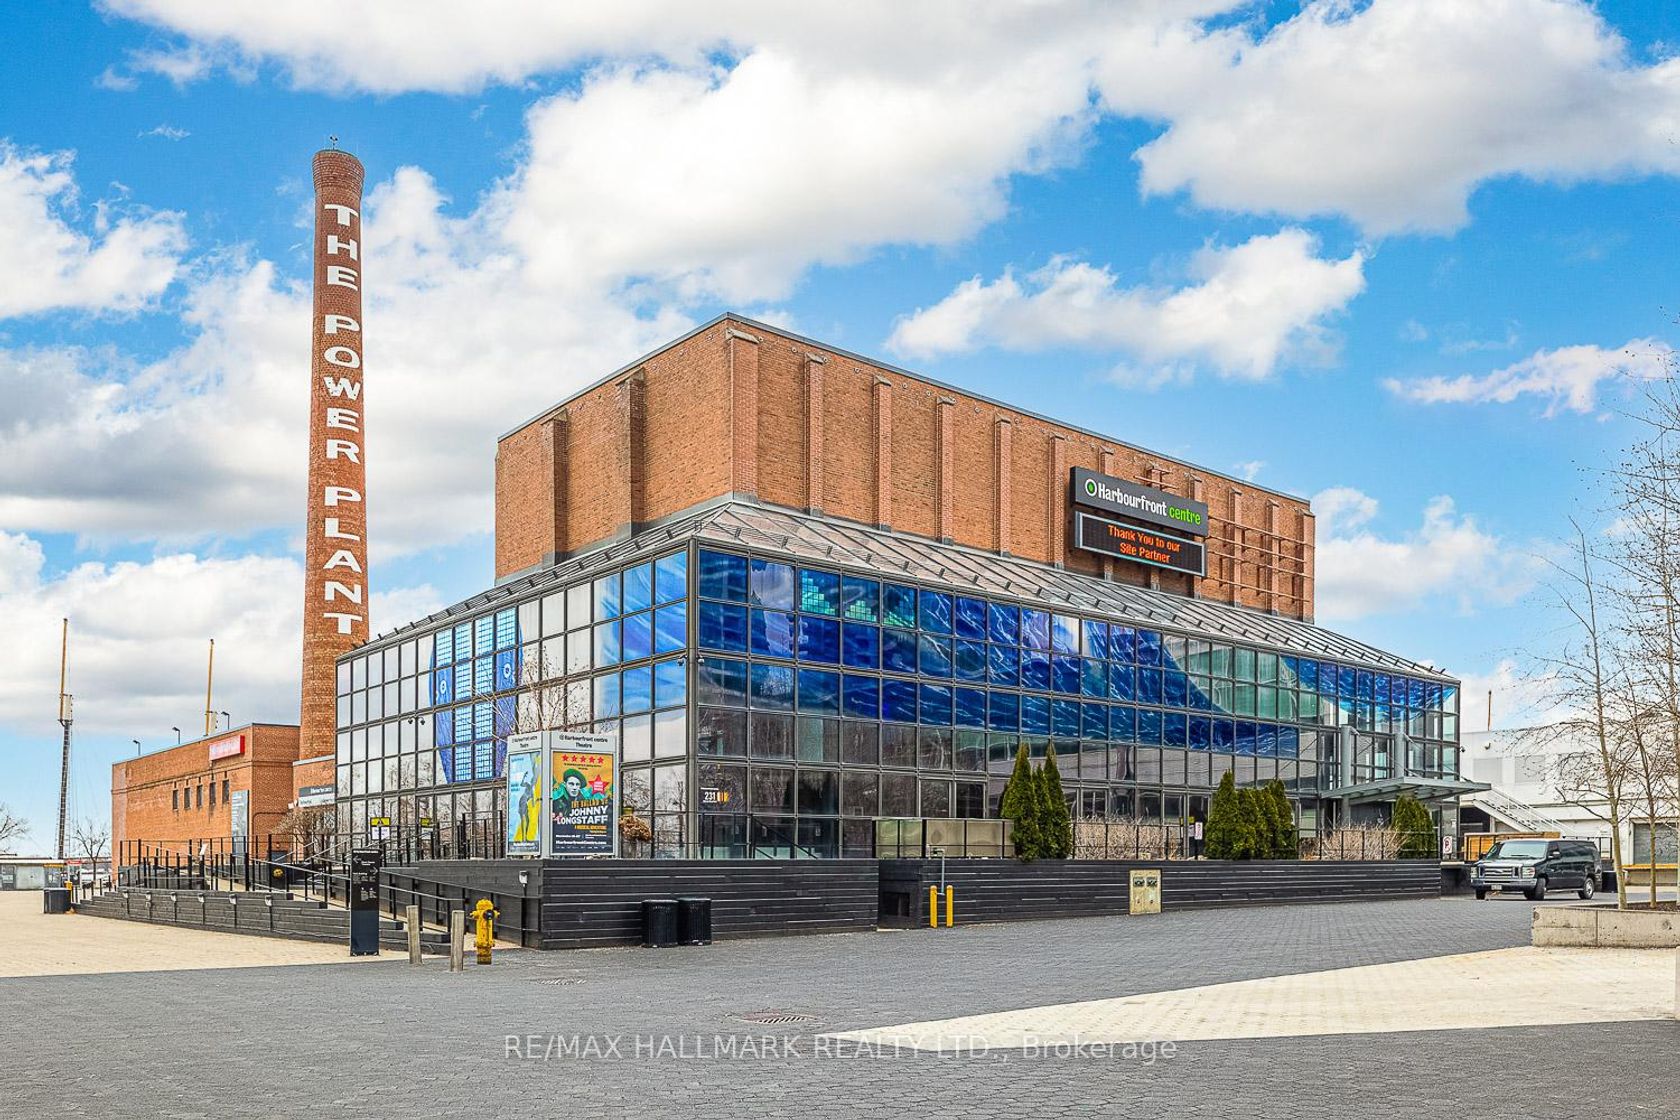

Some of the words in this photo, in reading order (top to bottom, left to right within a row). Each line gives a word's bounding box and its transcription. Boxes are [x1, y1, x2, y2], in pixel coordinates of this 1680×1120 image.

[324, 204, 358, 291] THE
[324, 314, 361, 464] POWER
[1098, 482, 1168, 516] Harbourfront
[1169, 506, 1201, 525] centre
[1108, 525, 1136, 541] Thank
[1137, 532, 1154, 546] You
[1155, 537, 1165, 548] to
[1166, 540, 1181, 552] our
[323, 486, 363, 635] PLANT
[1120, 542, 1137, 555] Site
[1139, 546, 1171, 563] Partner
[704, 791, 716, 801] 231
[556, 815, 608, 825] LONGSTAFF
[569, 805, 608, 817] JOHNNY
